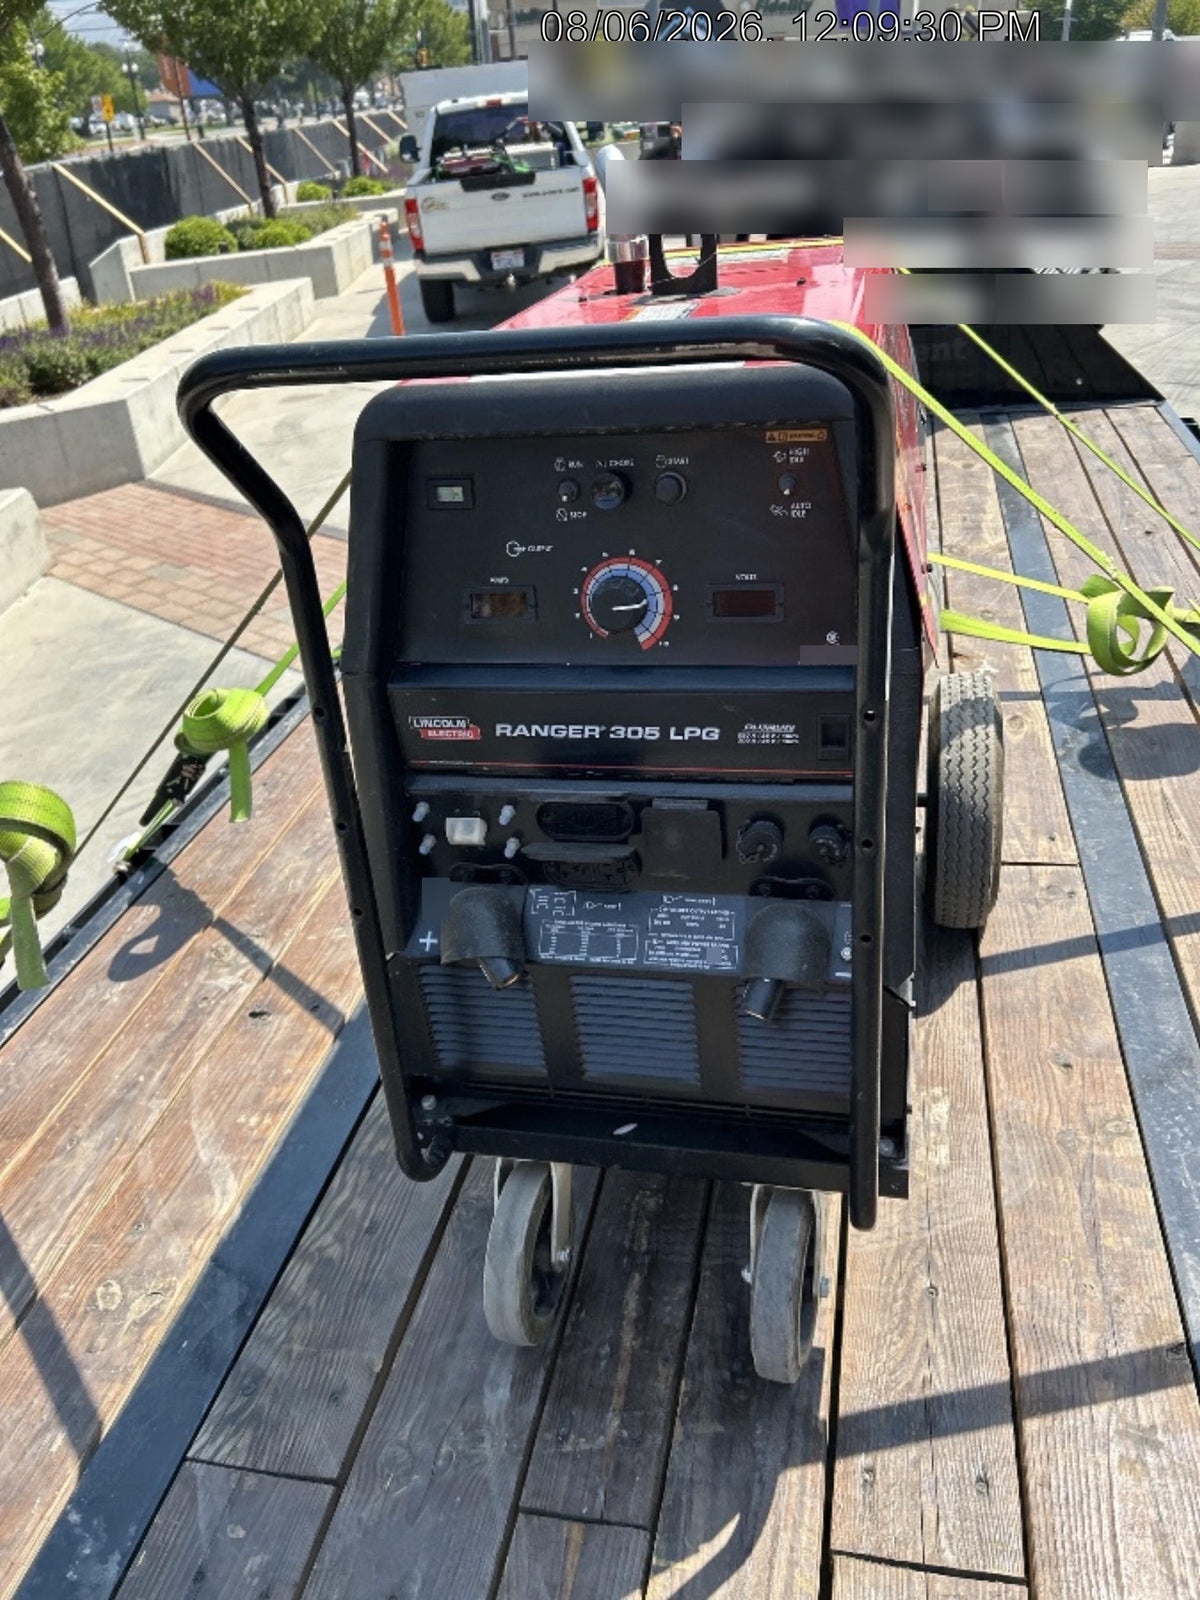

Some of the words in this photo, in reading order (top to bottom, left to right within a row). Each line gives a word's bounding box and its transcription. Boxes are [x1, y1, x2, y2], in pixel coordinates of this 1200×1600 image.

[412, 718, 467, 729] LINCOLN
[494, 723, 601, 739] RANGER
[609, 725, 661, 740] 305
[669, 726, 721, 741] LPG
